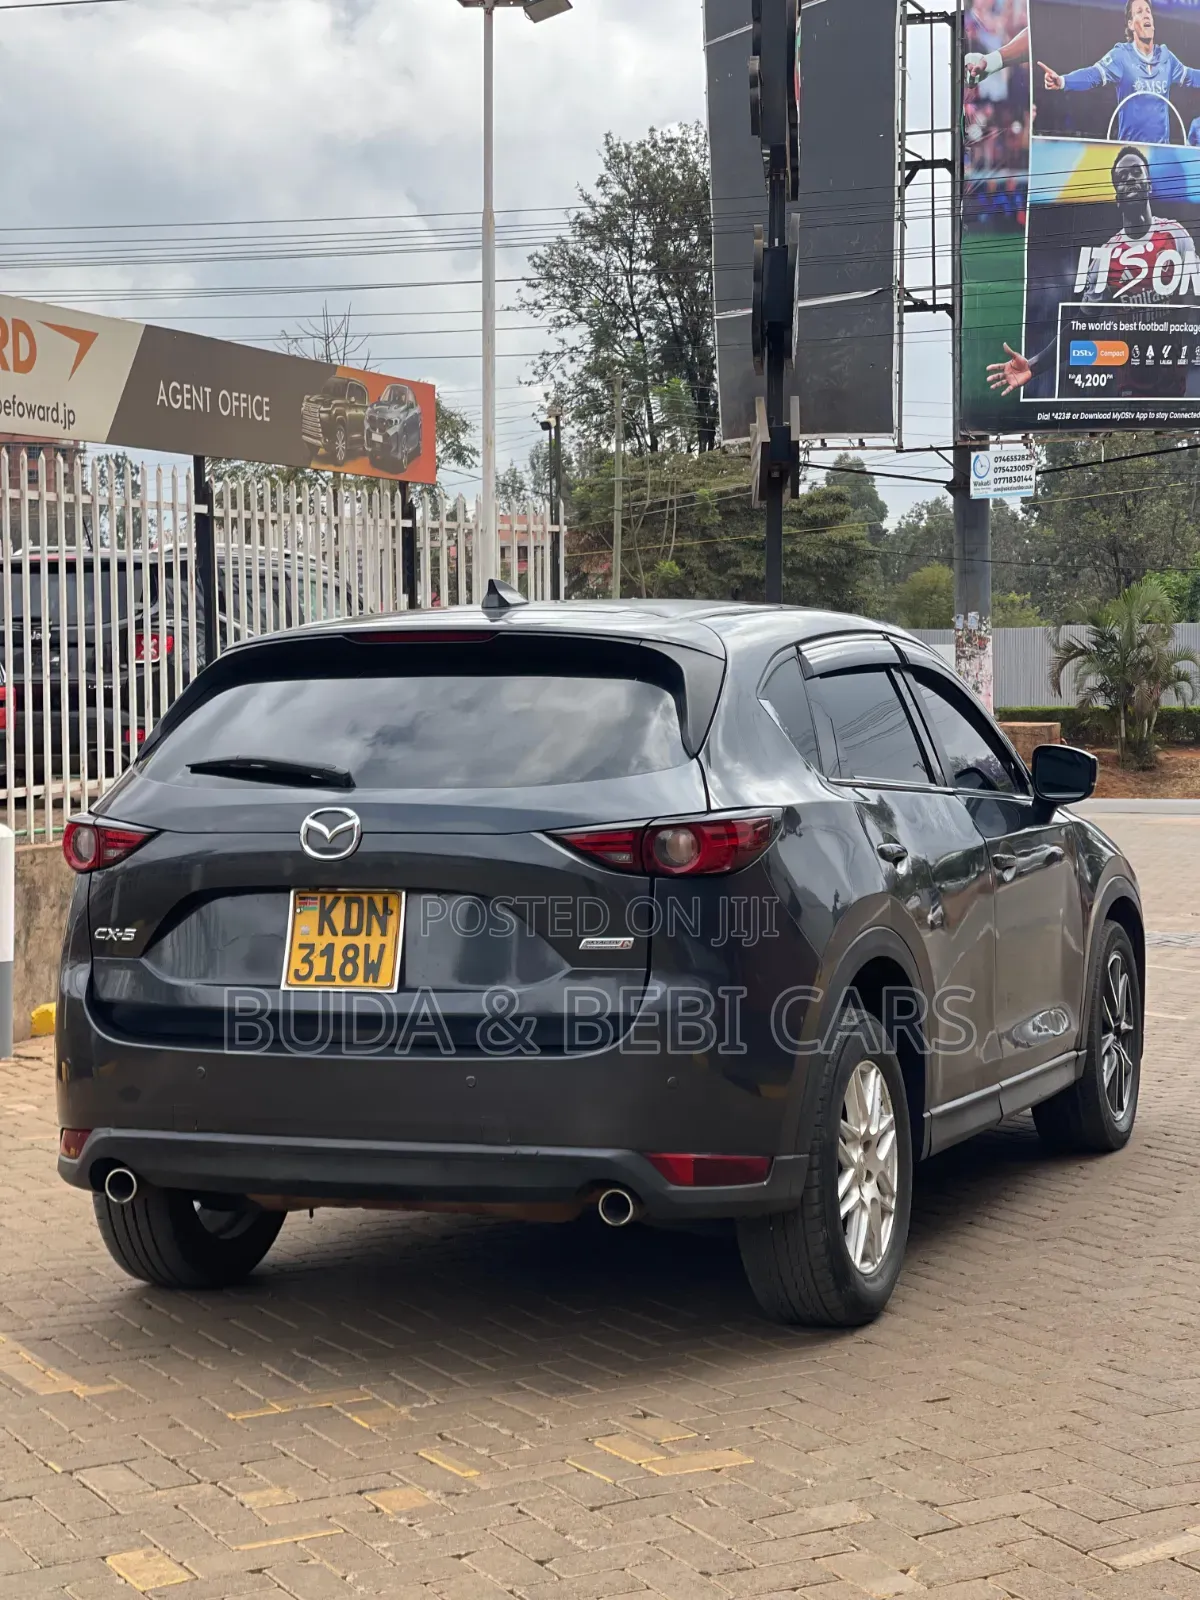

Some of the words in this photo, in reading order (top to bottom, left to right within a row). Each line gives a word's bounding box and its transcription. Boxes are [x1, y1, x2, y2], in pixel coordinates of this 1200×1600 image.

[1073, 244, 1155, 299] IT'S
[1071, 321, 1086, 331] The
[1088, 321, 1118, 332] world's
[1119, 321, 1137, 332] best
[1138, 321, 1169, 332] football
[1100, 350, 1125, 358] Compact
[1074, 373, 1107, 389] 4,200
[156, 379, 212, 413] AGENT
[218, 389, 271, 422] OFFICE
[0, 394, 76, 431] efoward.jp
[1037, 412, 1051, 421] Dial
[1080, 411, 1111, 420] Download
[1135, 411, 1148, 422] App
[1148, 411, 1156, 419] to
[1155, 411, 1169, 422] stay
[1169, 411, 1200, 420] Connected
[993, 475, 1033, 484] 0771830144
[317, 896, 390, 937] KDN
[93, 927, 137, 942] CX-5
[293, 943, 387, 984] 318W
